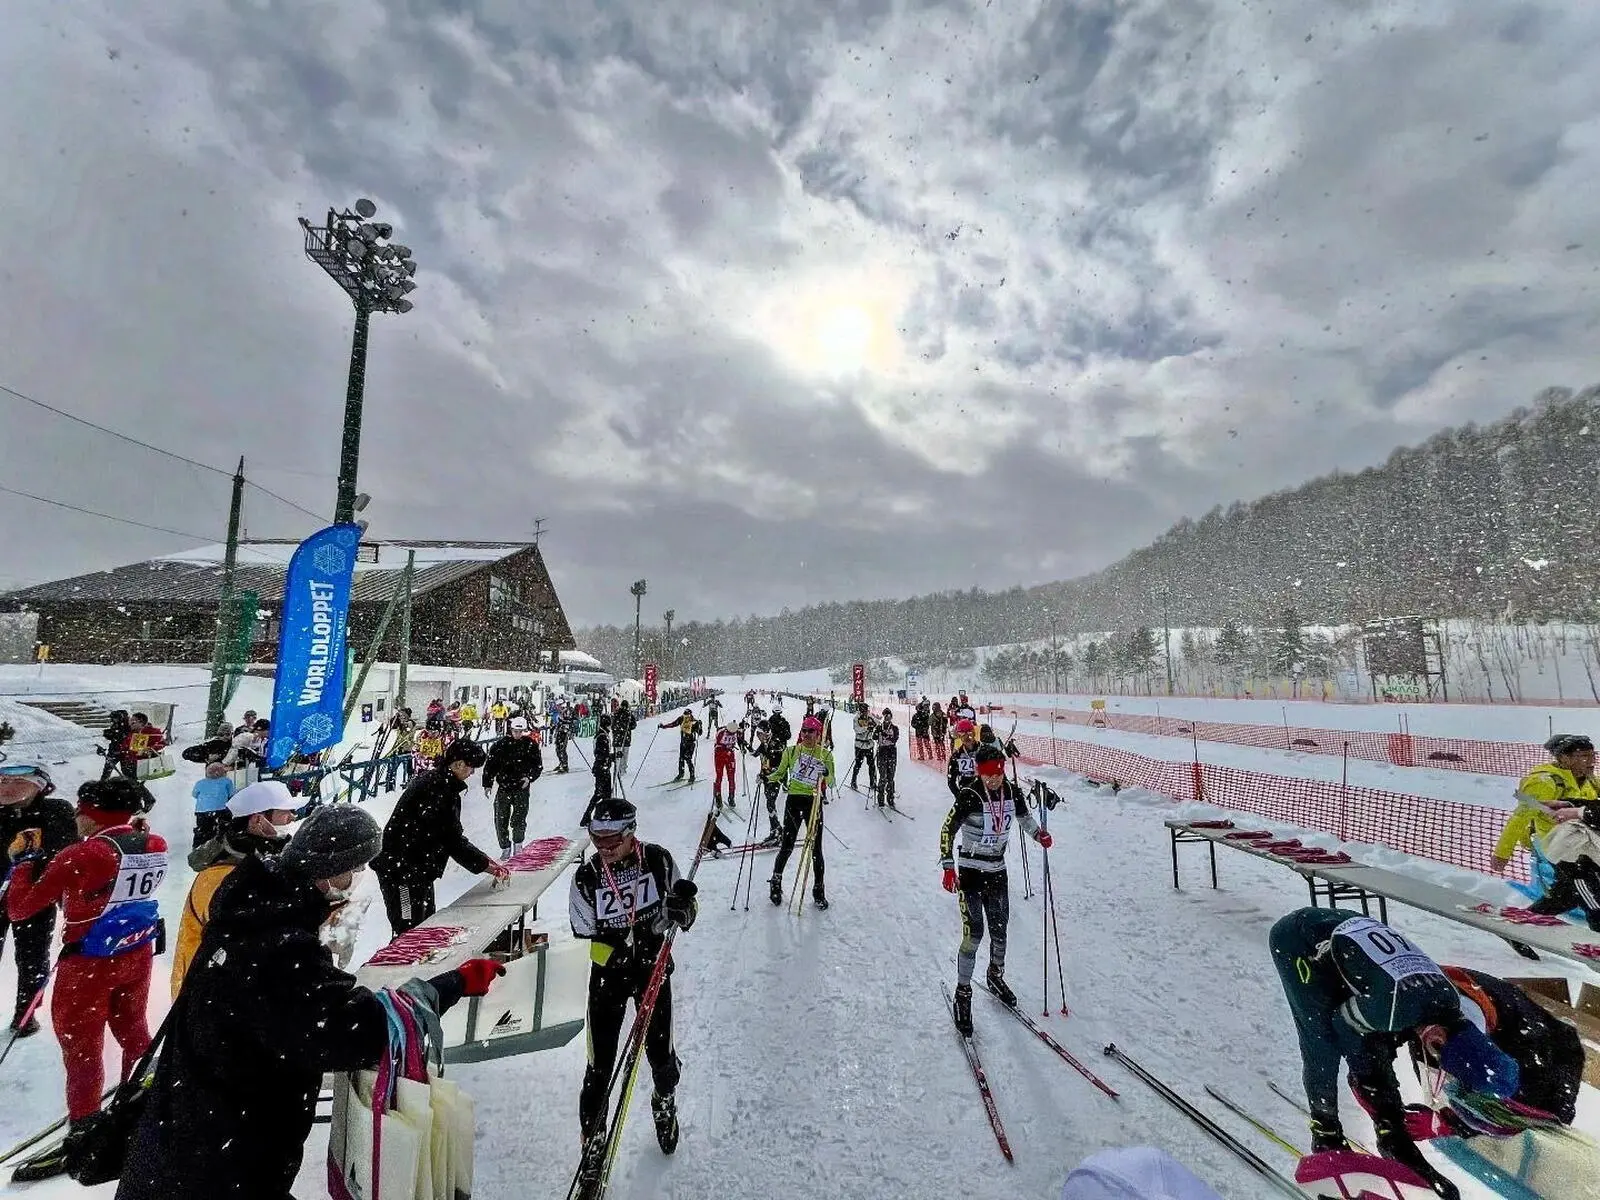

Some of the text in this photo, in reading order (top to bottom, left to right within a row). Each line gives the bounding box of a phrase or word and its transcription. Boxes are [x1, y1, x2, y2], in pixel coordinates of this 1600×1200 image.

[297, 579, 335, 706] WORLDLOPPET
[798, 762, 815, 777] 27
[601, 877, 650, 915] 257
